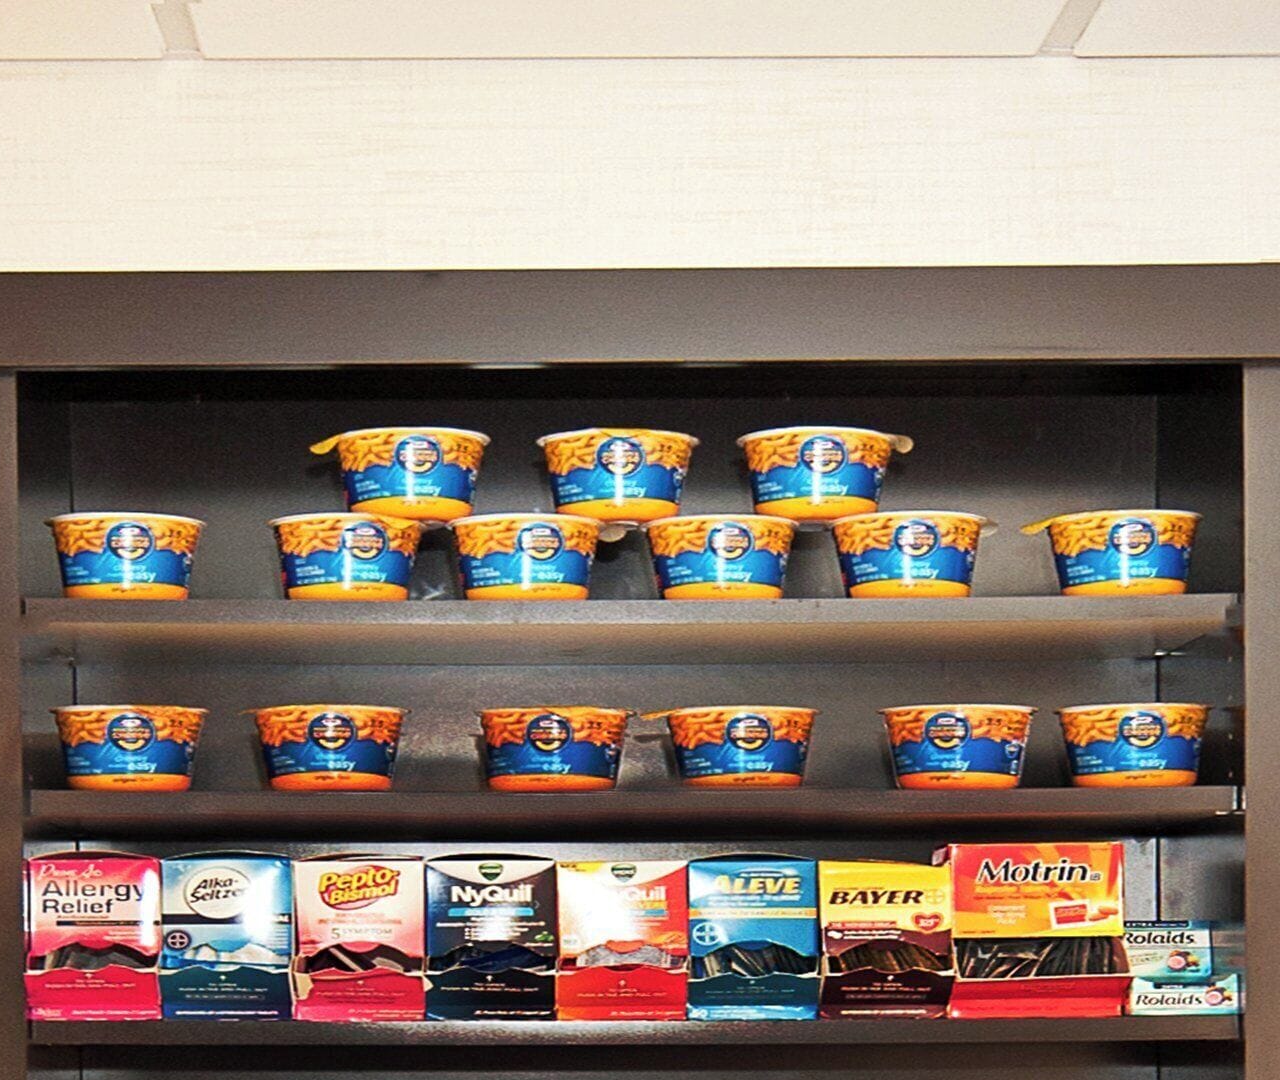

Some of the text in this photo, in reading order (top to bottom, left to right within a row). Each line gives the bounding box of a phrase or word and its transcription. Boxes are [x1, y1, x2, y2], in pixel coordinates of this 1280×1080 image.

[319, 867, 401, 891] Pepto-
[977, 858, 1090, 883] Motrin
[42, 880, 144, 902] Allergy
[196, 879, 240, 891] Alka-
[328, 881, 399, 905] Bismol
[714, 875, 801, 895] ALEVE
[451, 885, 535, 907] NyQuil
[828, 890, 925, 906] BAYER
[42, 899, 114, 914] Relief
[331, 928, 340, 939] 5
[1124, 931, 1196, 946] Rolaids
[1135, 993, 1203, 1006] Rolaids
